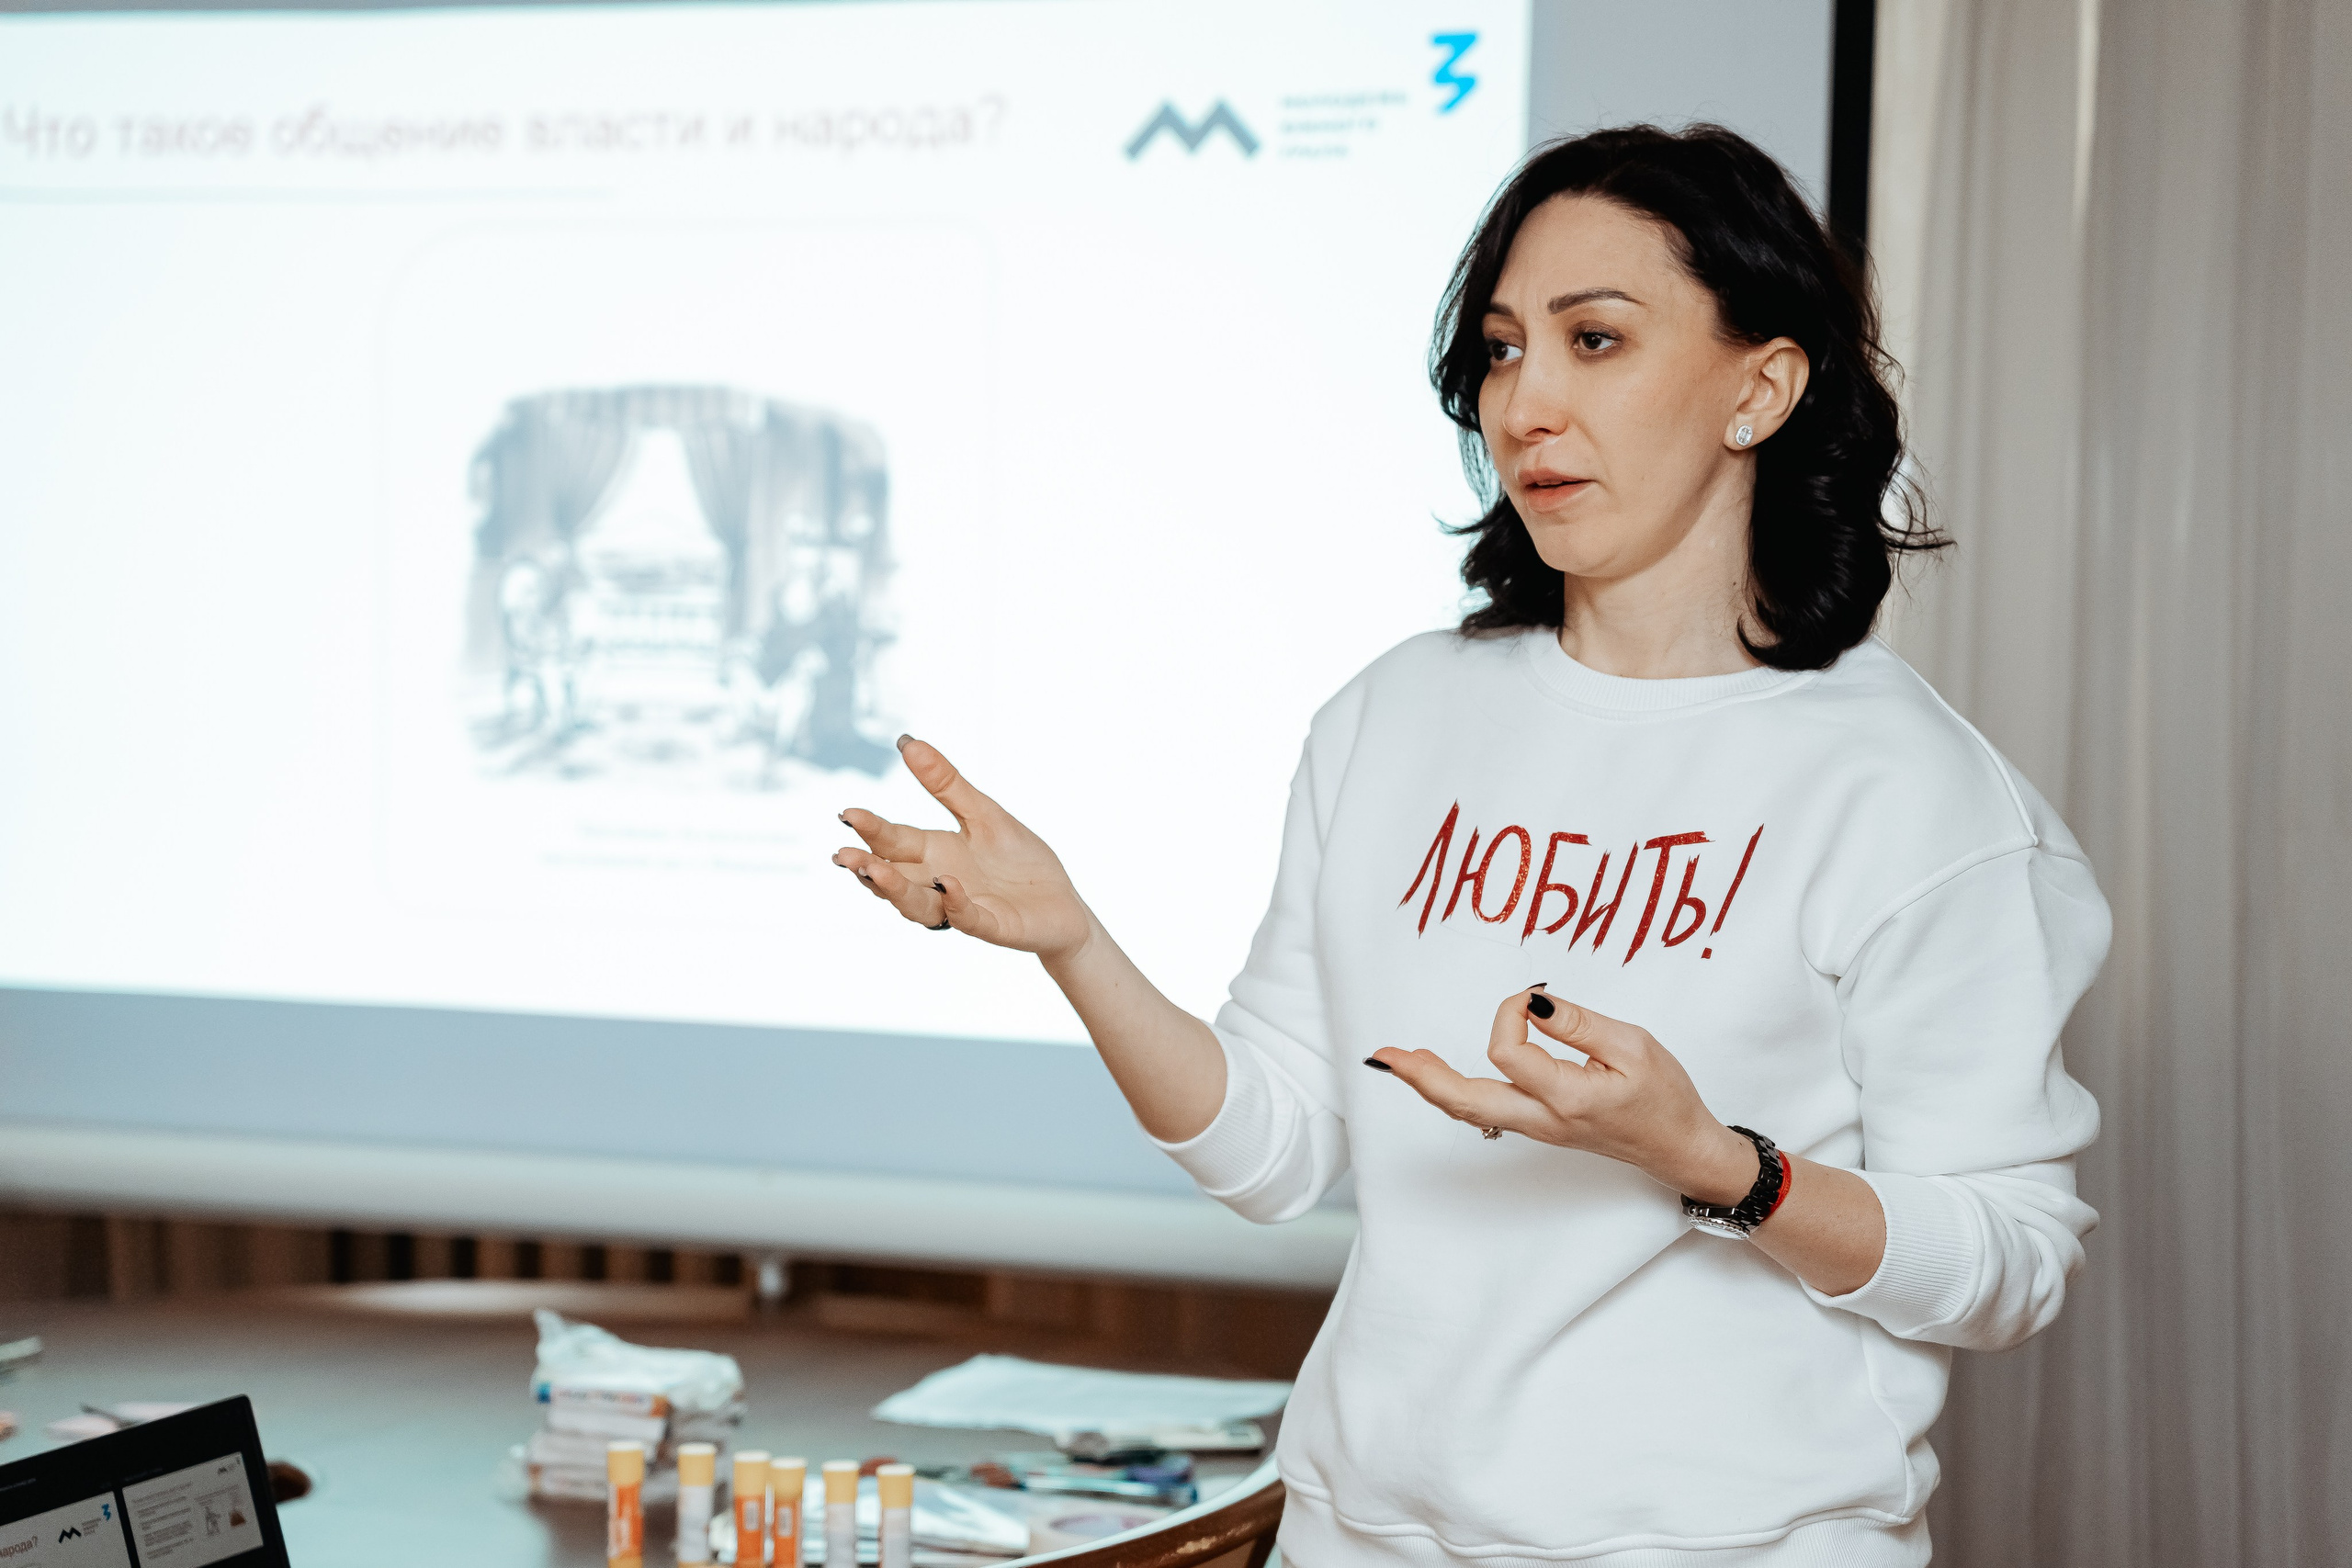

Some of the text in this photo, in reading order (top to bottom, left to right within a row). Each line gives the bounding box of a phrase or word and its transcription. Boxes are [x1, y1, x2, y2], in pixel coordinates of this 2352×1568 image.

[3, 93, 1008, 164] Что такое общение власти и народа?
[1396, 798, 1764, 967] ЛЮБИТЬ!
